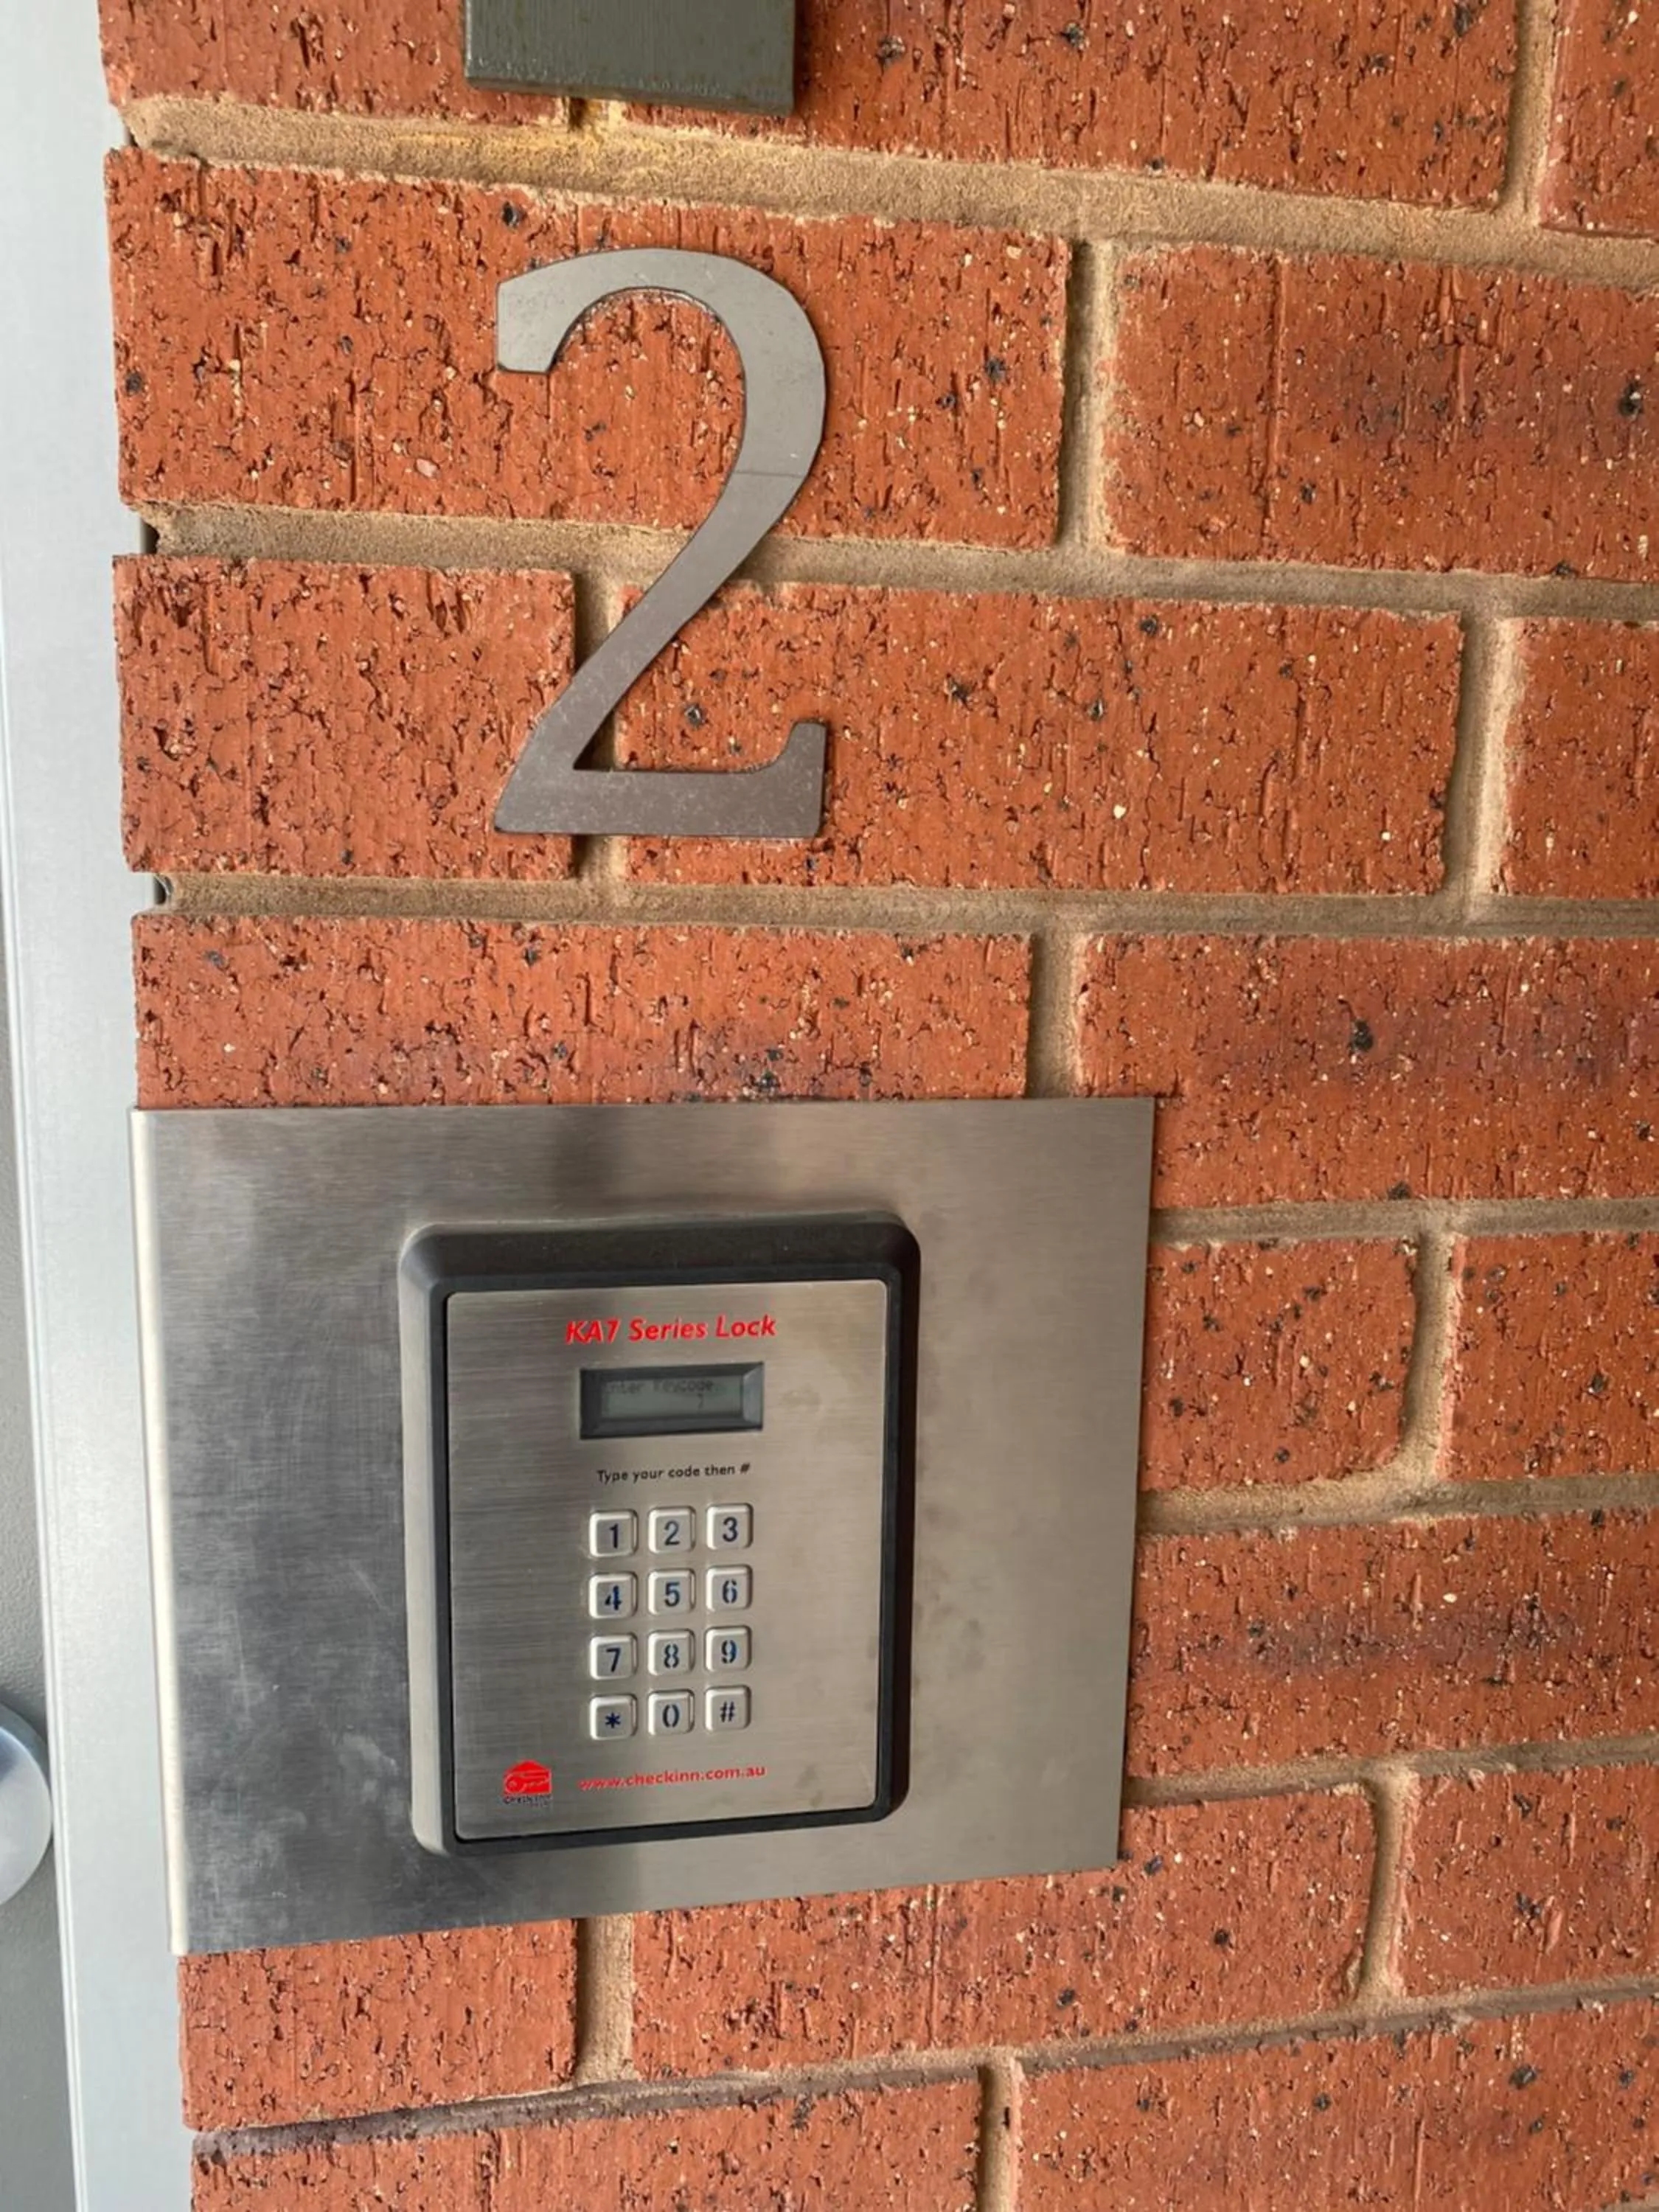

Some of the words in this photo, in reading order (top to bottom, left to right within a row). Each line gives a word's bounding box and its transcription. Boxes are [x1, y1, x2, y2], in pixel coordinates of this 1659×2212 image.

[495, 247, 827, 838] 2
[565, 1317, 620, 1345] KA7
[628, 1316, 709, 1342] Series
[714, 1313, 777, 1338] Lock
[596, 1470, 628, 1483] Type
[632, 1470, 664, 1484] your
[667, 1464, 700, 1478] code
[704, 1464, 736, 1476] then
[739, 1462, 751, 1475] #
[609, 1523, 619, 1548] 1
[664, 1520, 681, 1546] 2
[722, 1517, 738, 1543] 3
[605, 1585, 622, 1610] 4
[664, 1582, 681, 1607] 5
[722, 1579, 738, 1604] 6
[605, 1647, 621, 1672] 7
[664, 1644, 680, 1669] 8
[721, 1639, 737, 1664] 9
[662, 1704, 680, 1728] 0
[720, 1701, 736, 1722] #
[577, 1764, 767, 1790] www.checkinn.com.au
